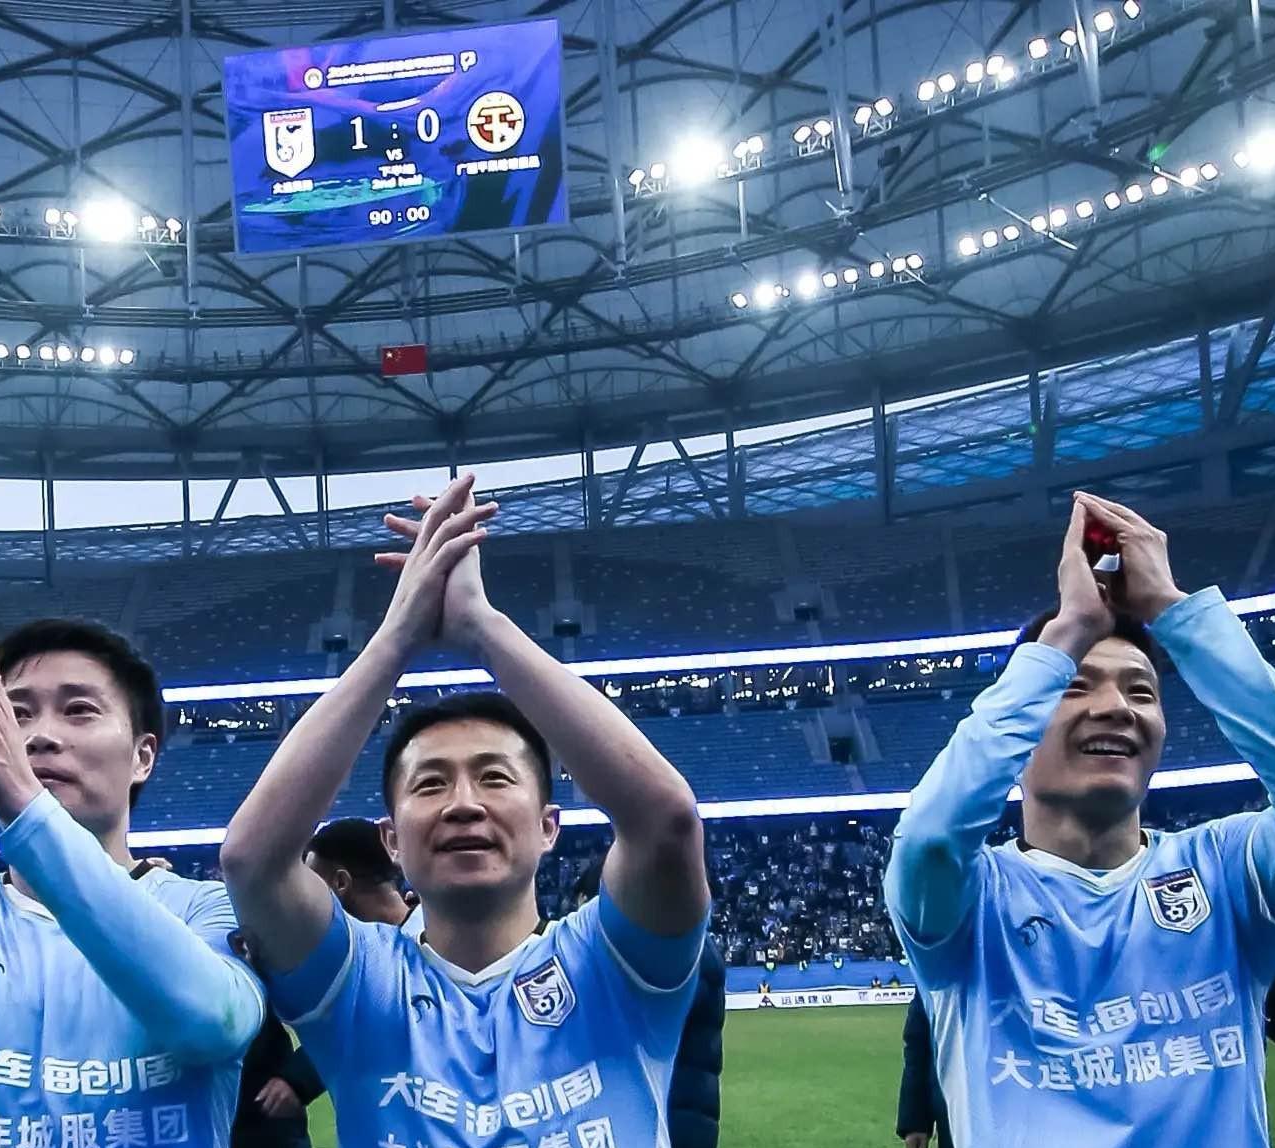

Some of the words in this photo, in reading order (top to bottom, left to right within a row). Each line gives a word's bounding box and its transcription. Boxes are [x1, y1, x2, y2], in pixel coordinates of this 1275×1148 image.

[350, 116, 368, 150] 1
[417, 107, 440, 142] 0
[991, 1024, 1247, 1092] 大连城服集团
[378, 1060, 604, 1137] 大连海创周
